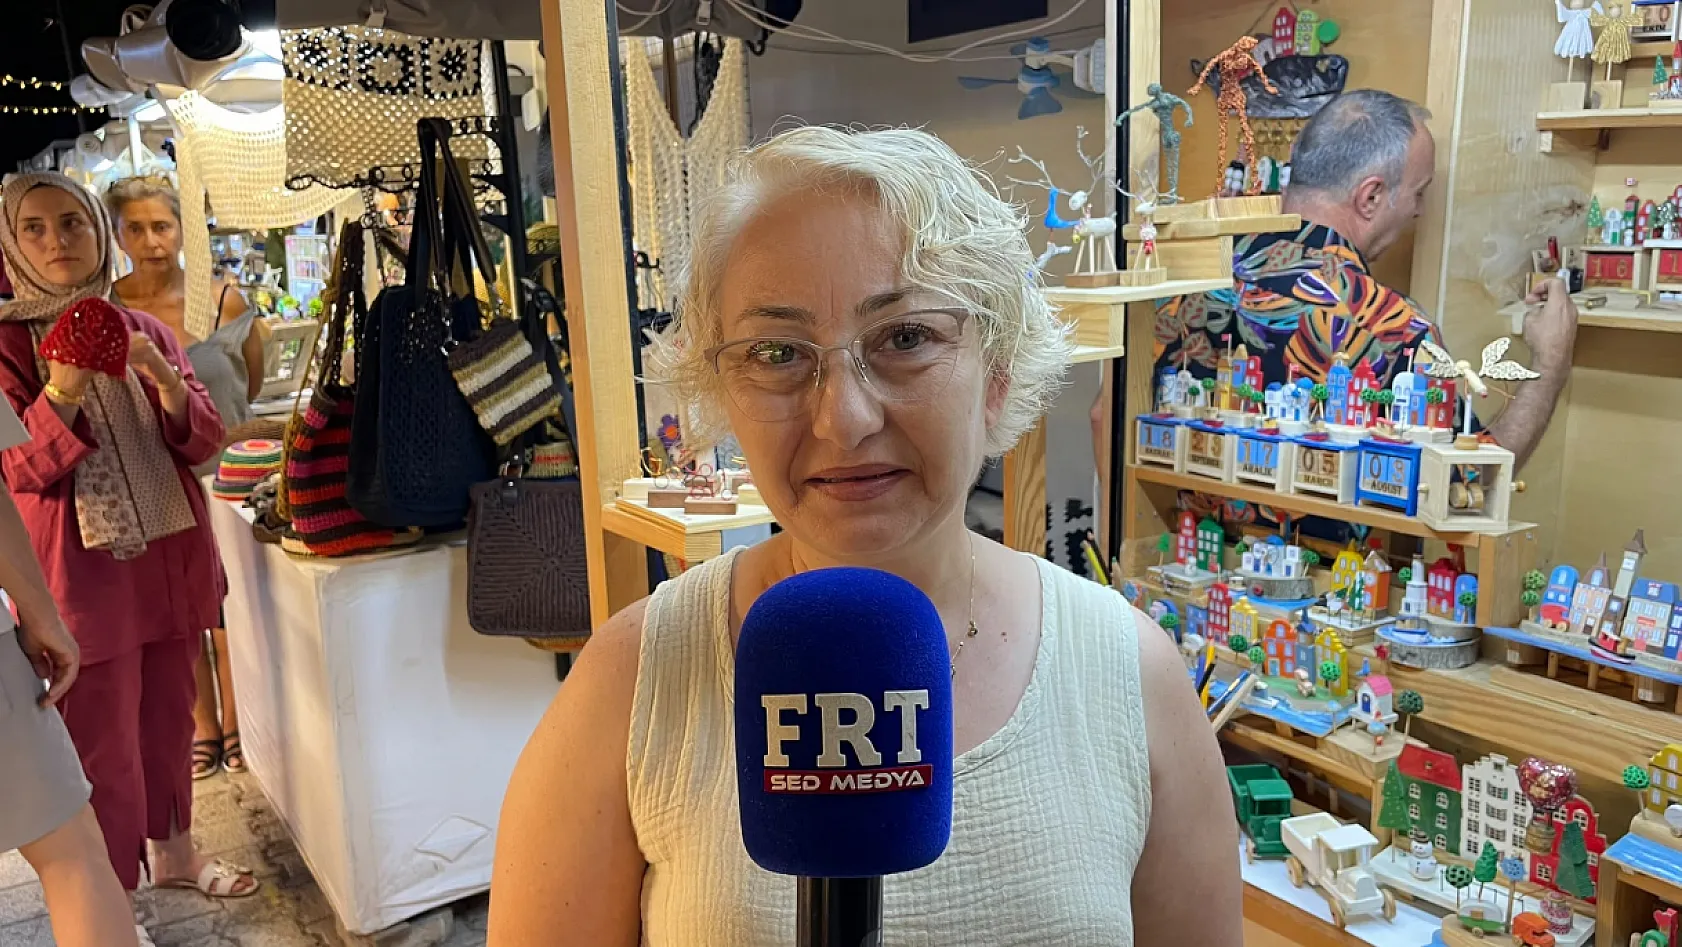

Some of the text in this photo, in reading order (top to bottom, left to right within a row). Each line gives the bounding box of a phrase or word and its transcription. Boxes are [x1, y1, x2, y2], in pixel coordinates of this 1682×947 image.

[1371, 480, 1402, 496] AUGUST
[760, 688, 930, 768] FRT
[770, 769, 925, 791] SED MEDYA
